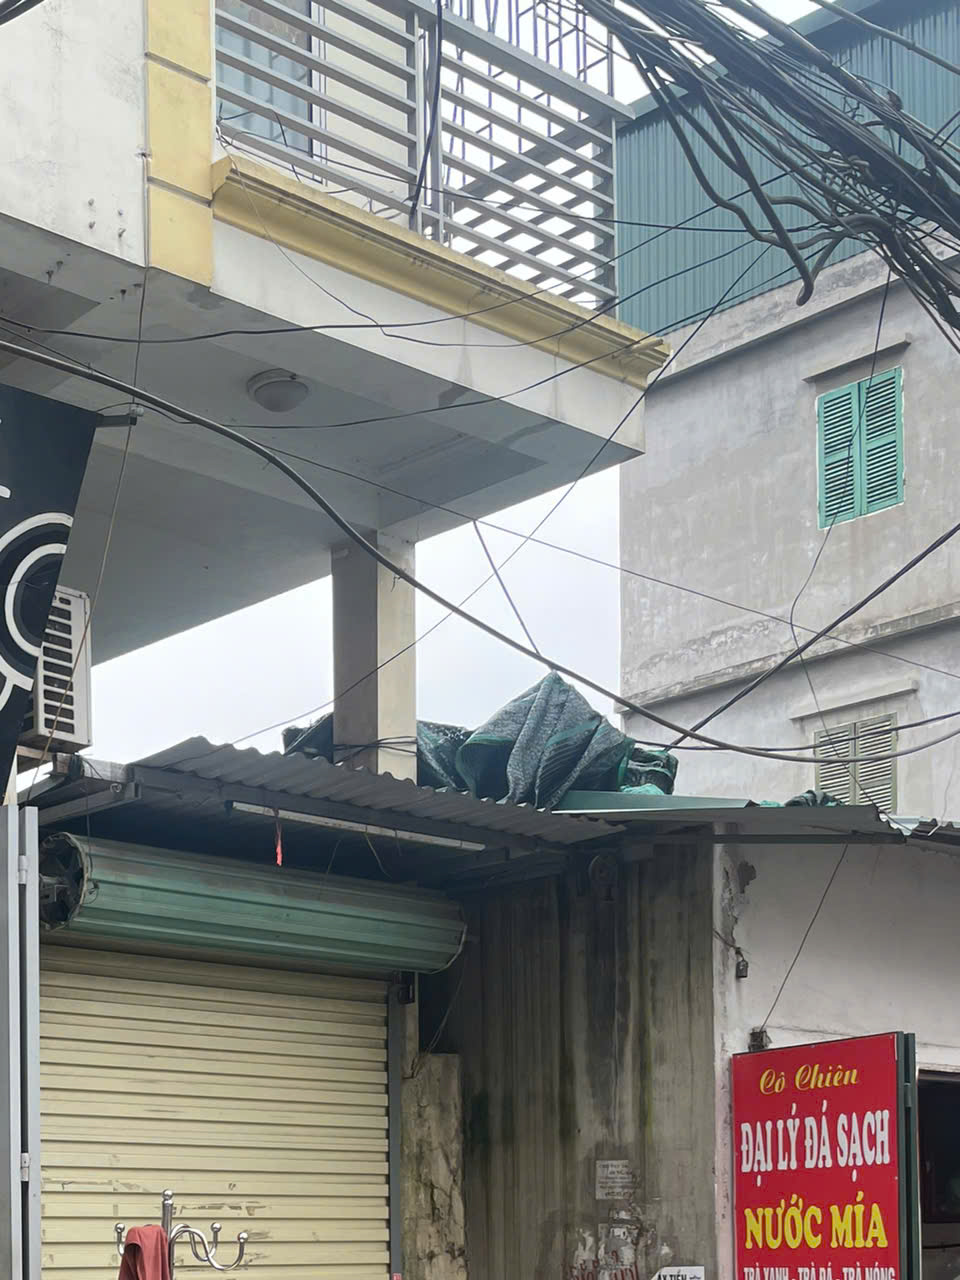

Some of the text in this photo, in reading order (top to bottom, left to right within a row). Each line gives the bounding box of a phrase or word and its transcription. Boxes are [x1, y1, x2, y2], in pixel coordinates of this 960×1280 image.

[759, 1063, 860, 1095] Cô Chiên
[741, 1099, 890, 1187] ĐẠI LÝ ĐÁ SẠCH
[744, 1190, 889, 1250] NƯỚC MÍA
